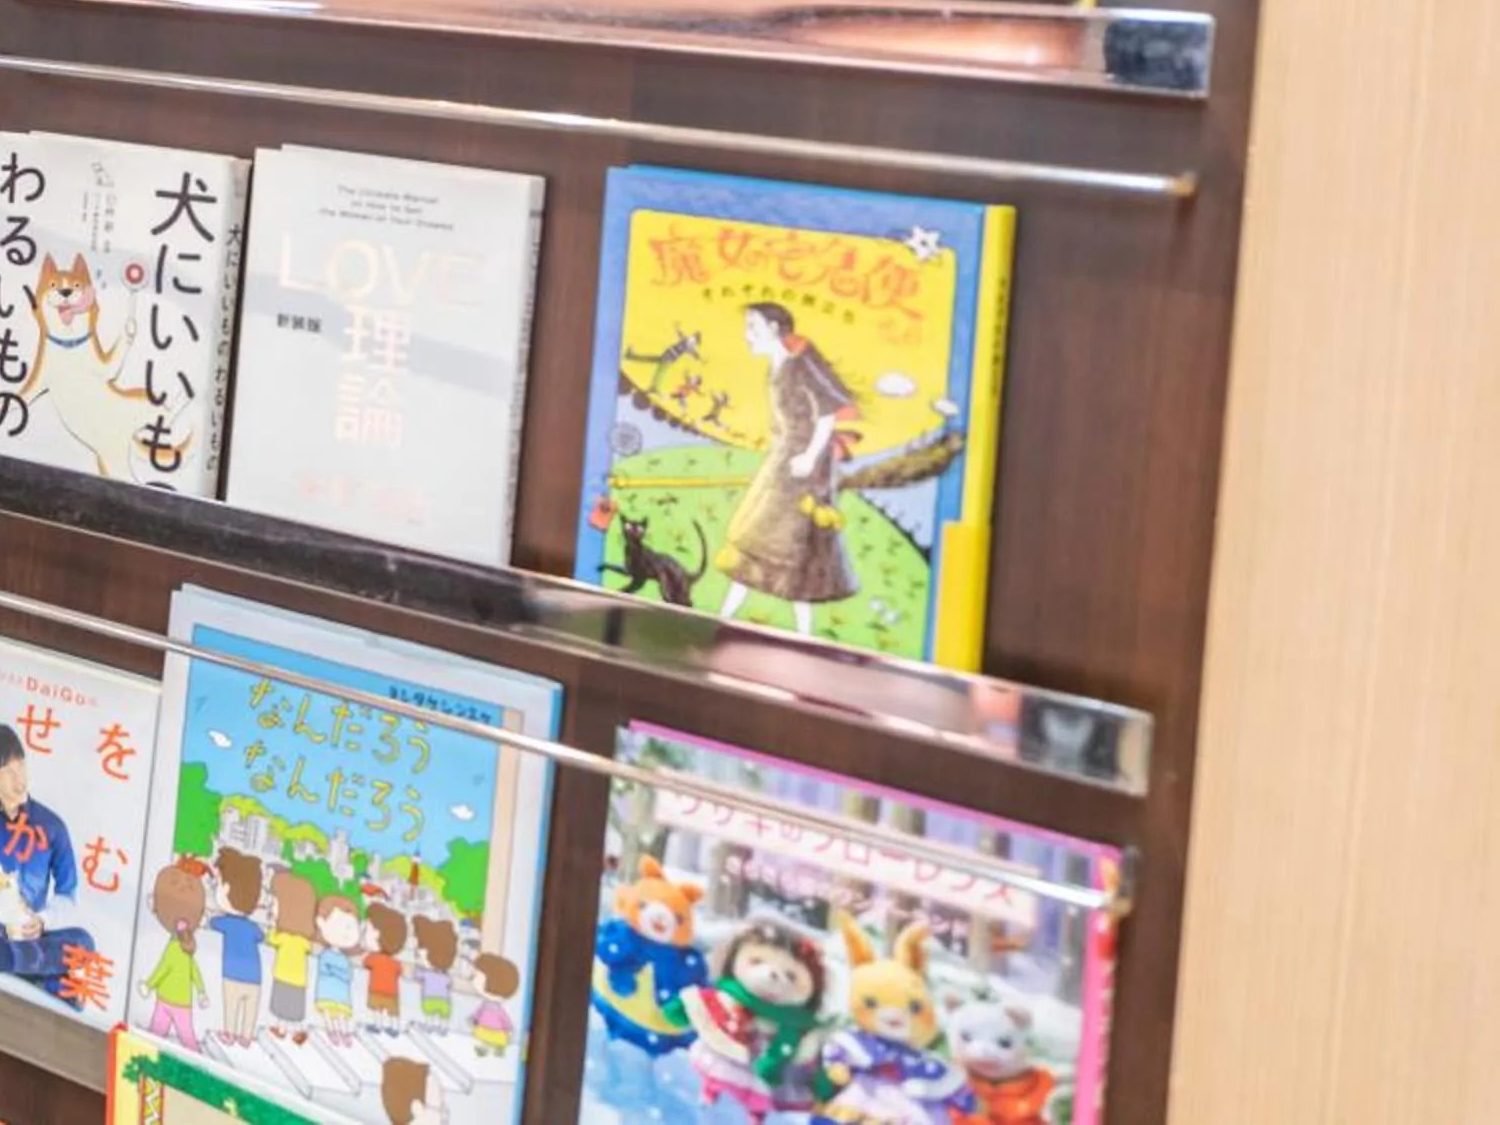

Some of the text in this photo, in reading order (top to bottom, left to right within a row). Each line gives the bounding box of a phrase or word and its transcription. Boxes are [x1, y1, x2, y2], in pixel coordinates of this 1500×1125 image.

[277, 232, 487, 307] LOVE
[650, 221, 924, 320] 魔女の宅急便
[133, 171, 218, 491] 犬にいいも
[335, 303, 411, 445] 理論
[249, 677, 432, 774] なんだろう
[244, 739, 426, 842] なんだろう
